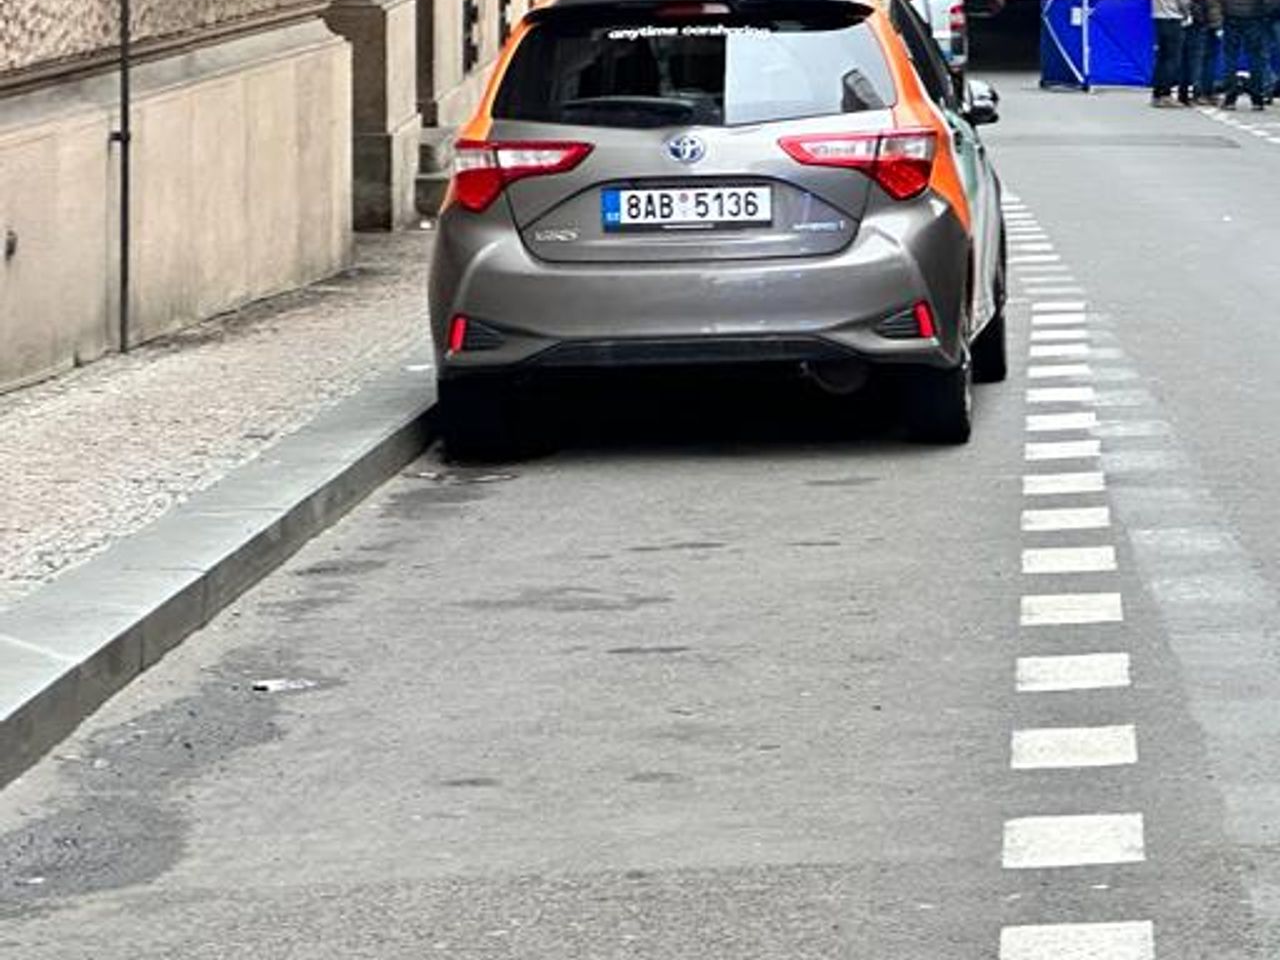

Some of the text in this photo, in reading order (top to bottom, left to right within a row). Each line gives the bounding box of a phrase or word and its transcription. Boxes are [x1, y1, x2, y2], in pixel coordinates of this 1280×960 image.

[607, 25, 678, 41] anytime
[626, 191, 759, 220] 8AB 5136
